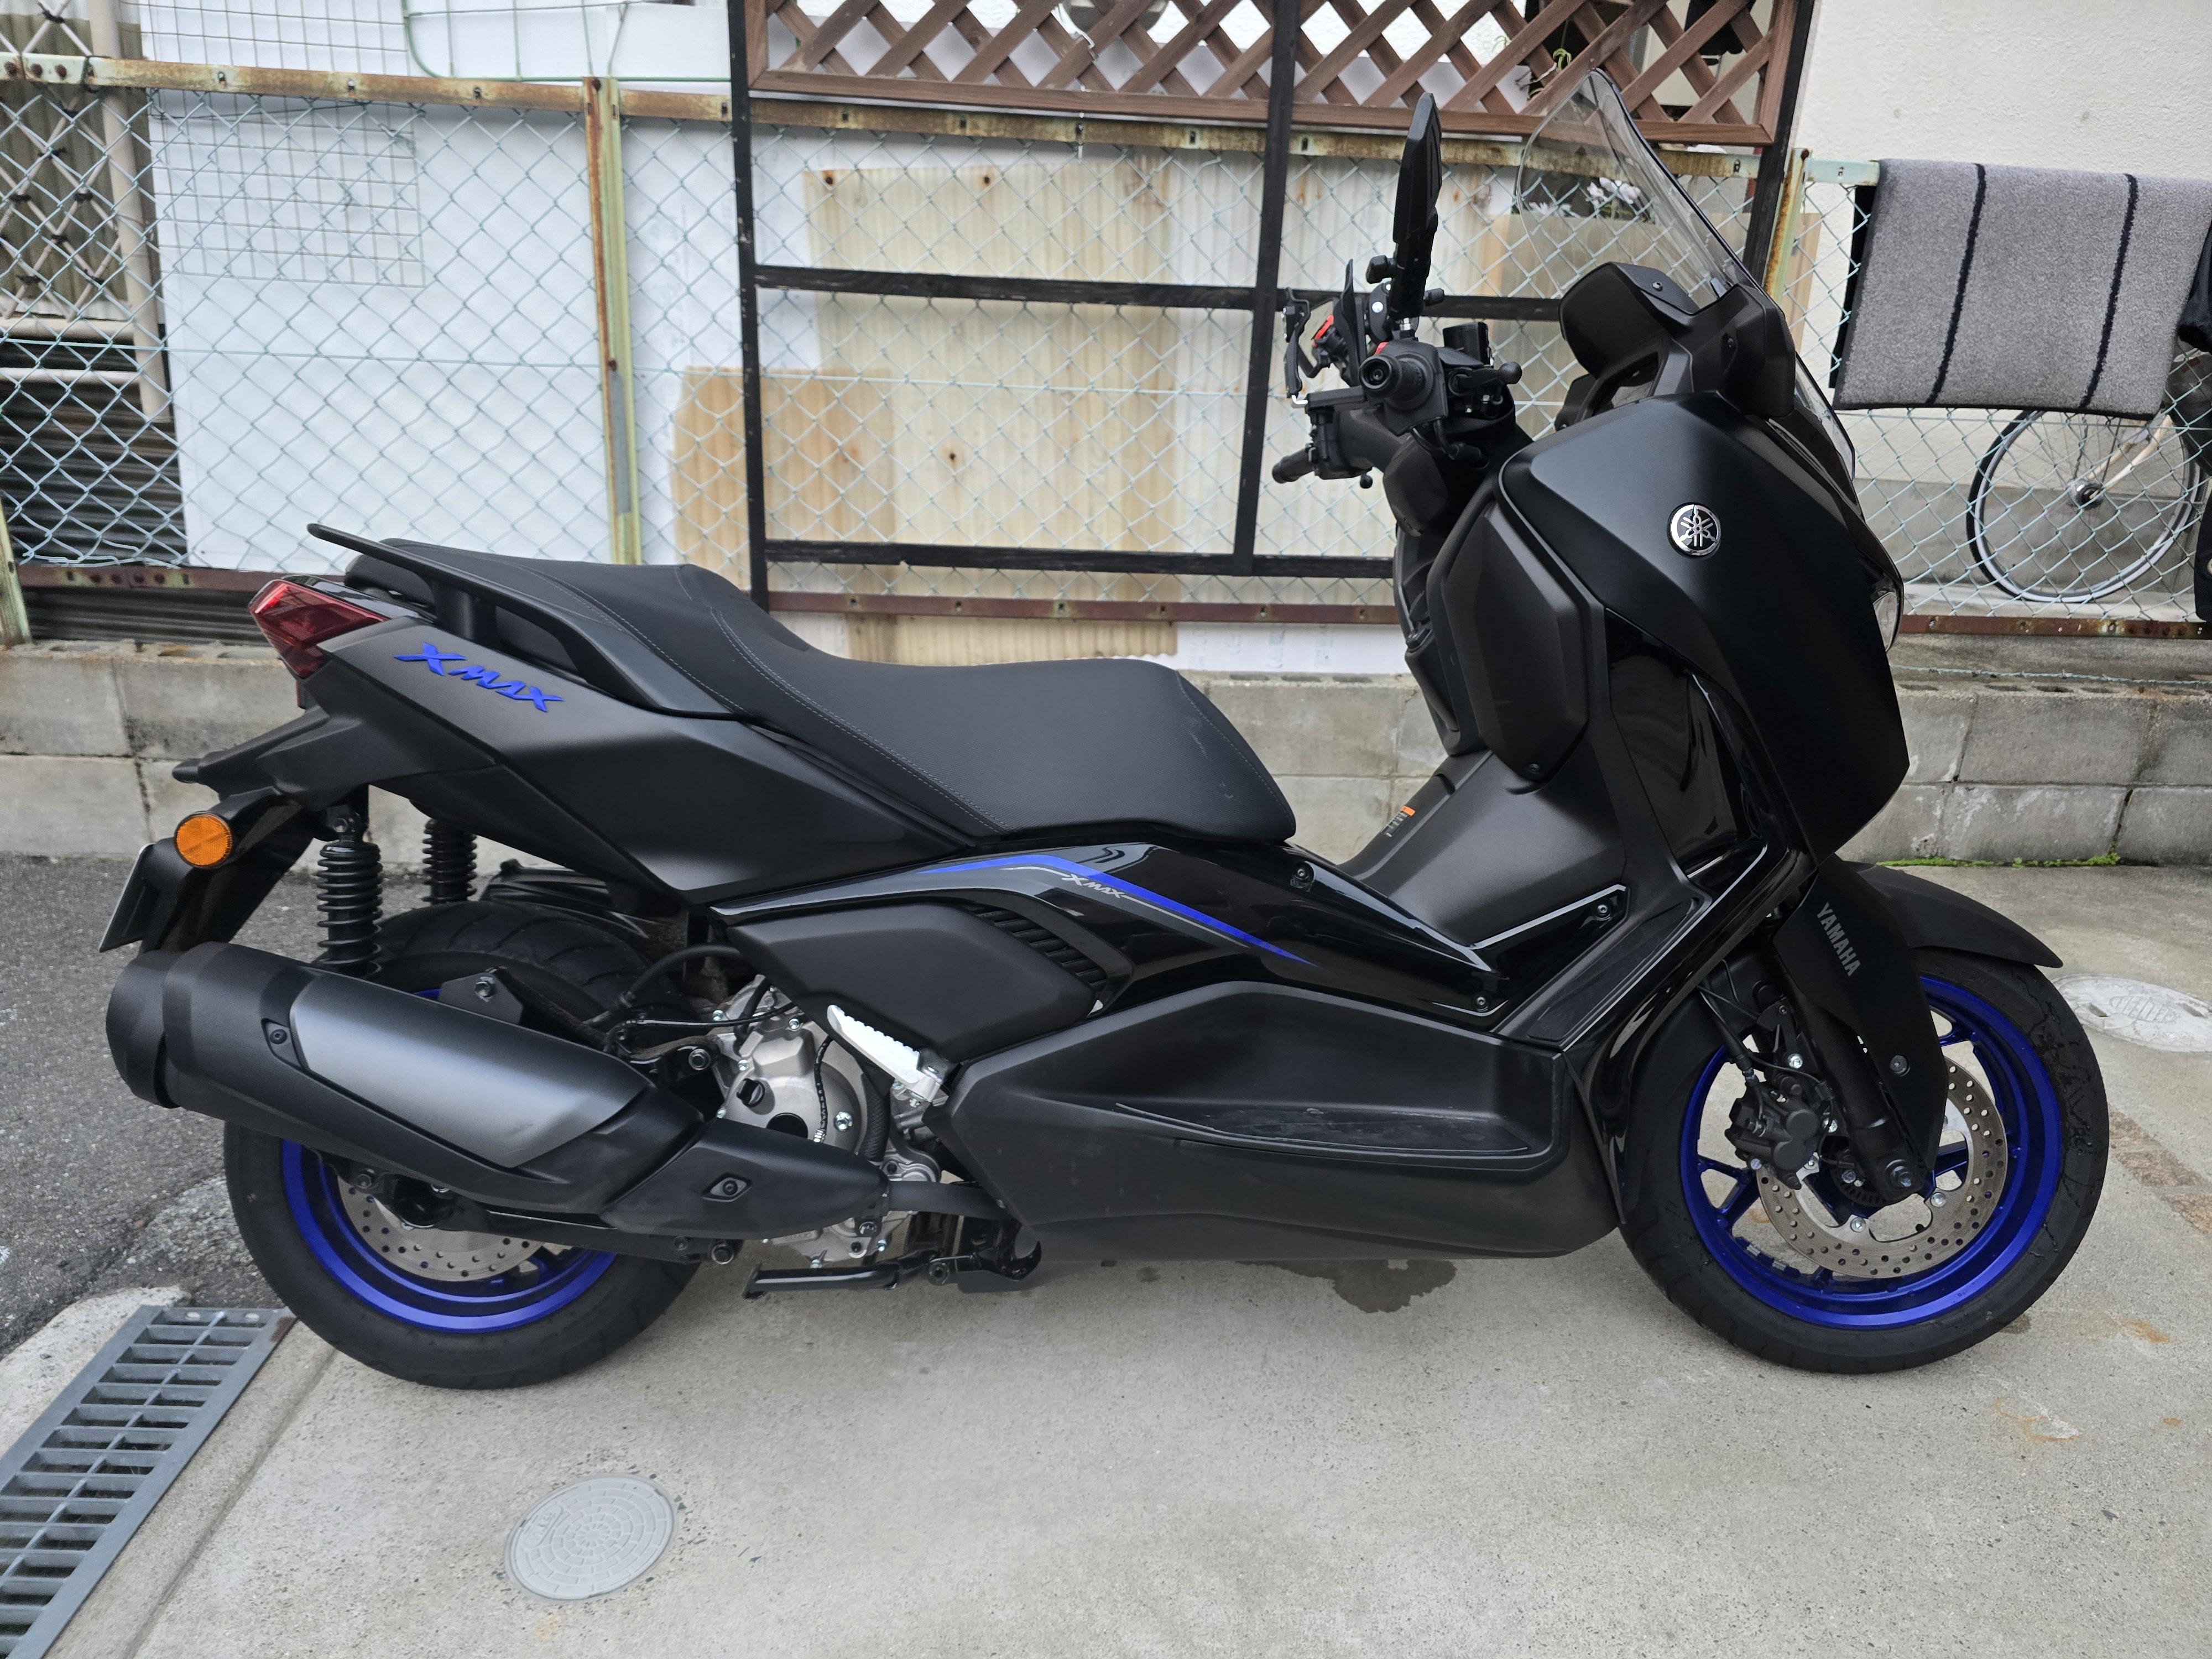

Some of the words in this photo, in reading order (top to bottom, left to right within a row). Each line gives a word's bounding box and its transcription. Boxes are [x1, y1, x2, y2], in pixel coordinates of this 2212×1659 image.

[394, 641, 564, 713] XMAX
[1061, 874, 1125, 898] XMAX
[1817, 902, 1860, 977] YAMAHA
